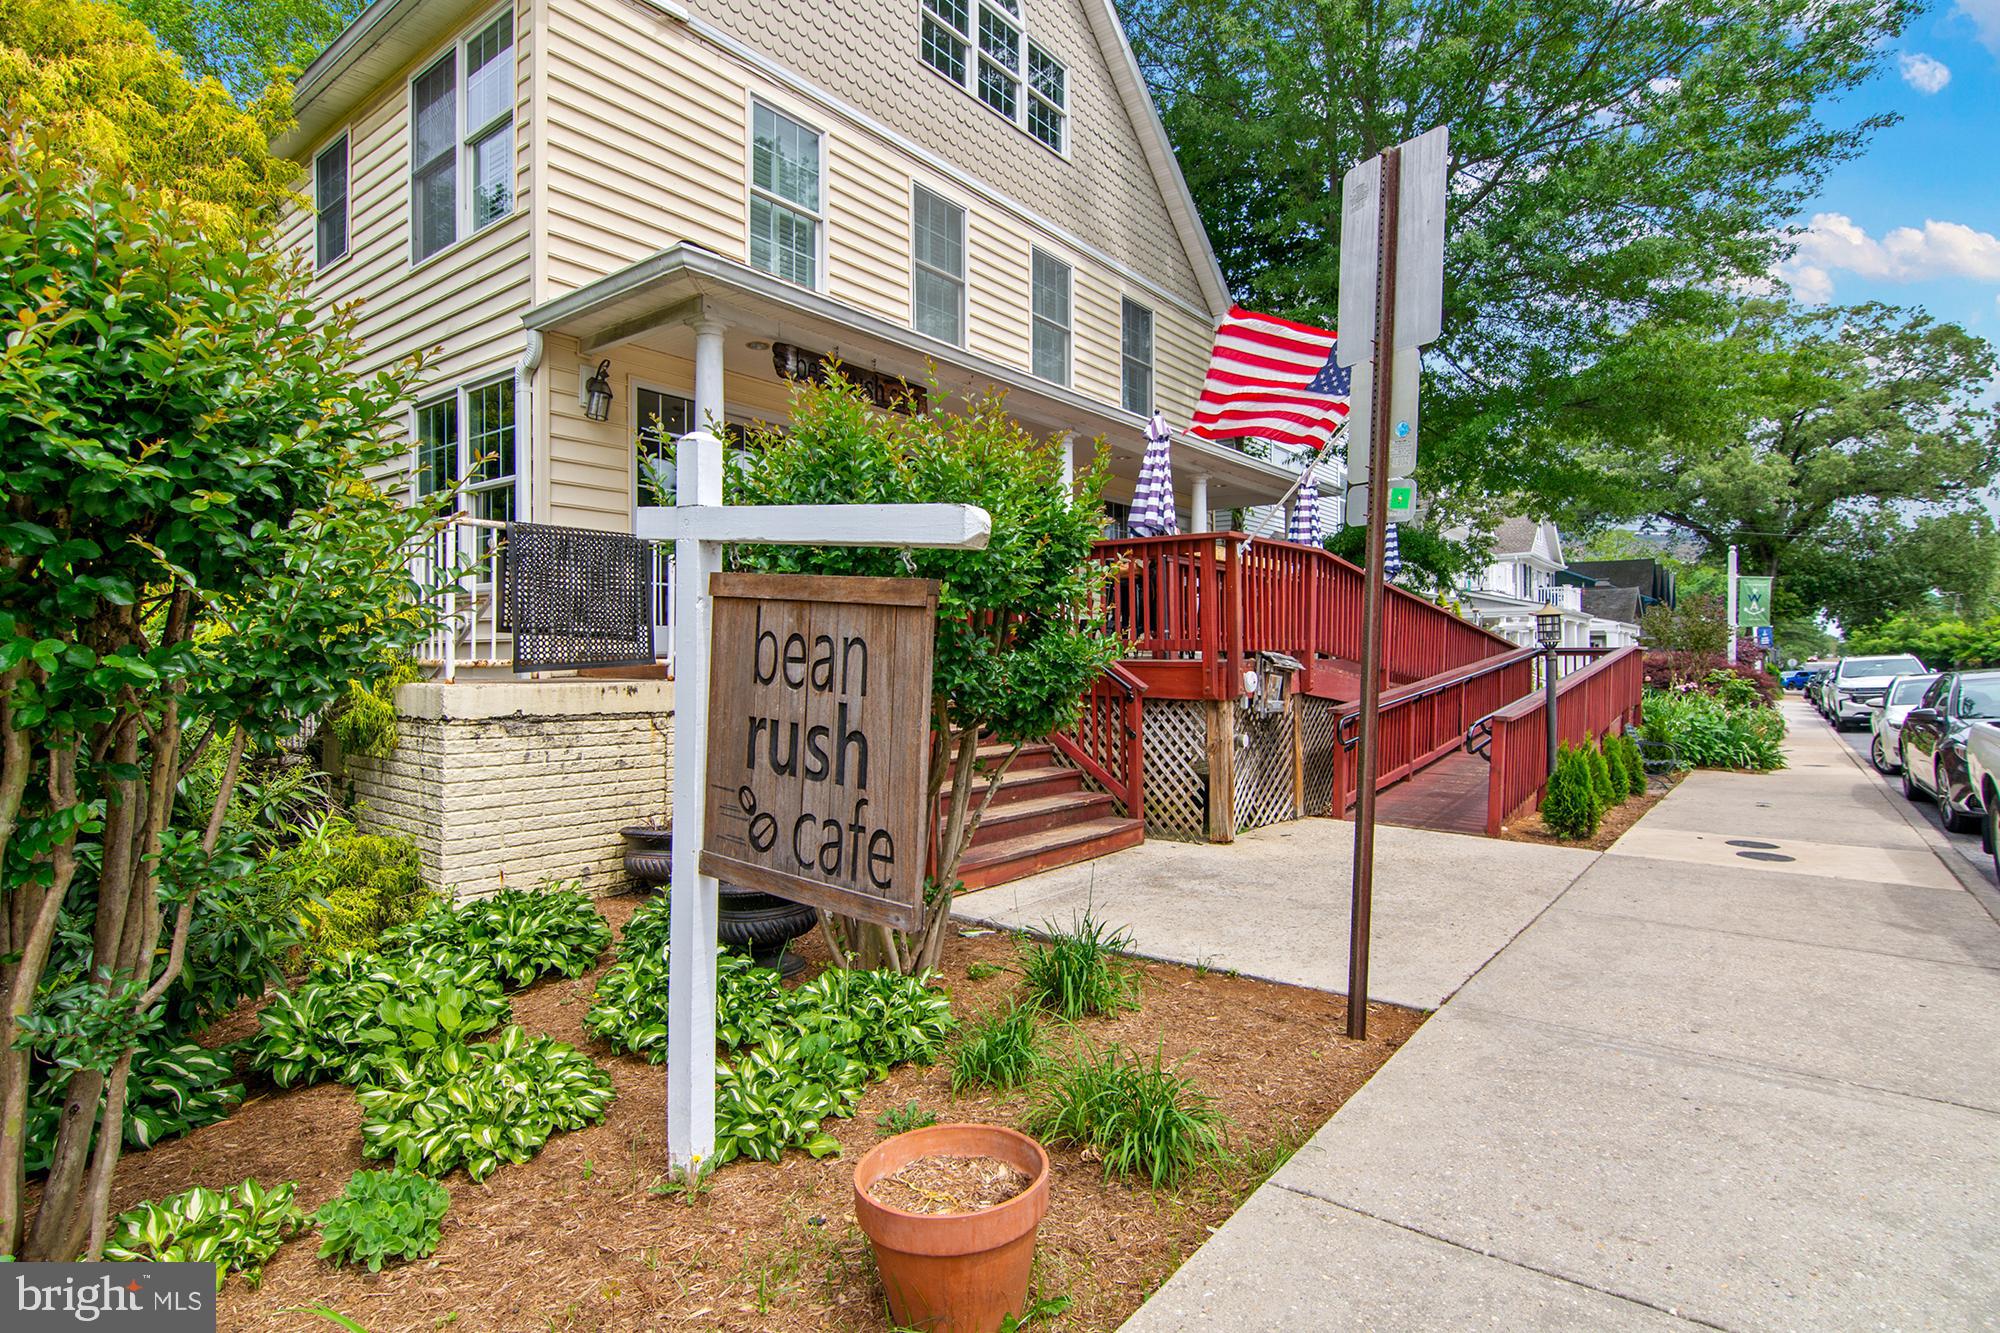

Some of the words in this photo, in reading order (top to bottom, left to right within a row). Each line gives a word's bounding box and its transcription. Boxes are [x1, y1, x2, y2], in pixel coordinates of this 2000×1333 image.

[753, 605, 868, 697] bean
[747, 702, 868, 789] rush
[793, 798, 895, 889] cafe
